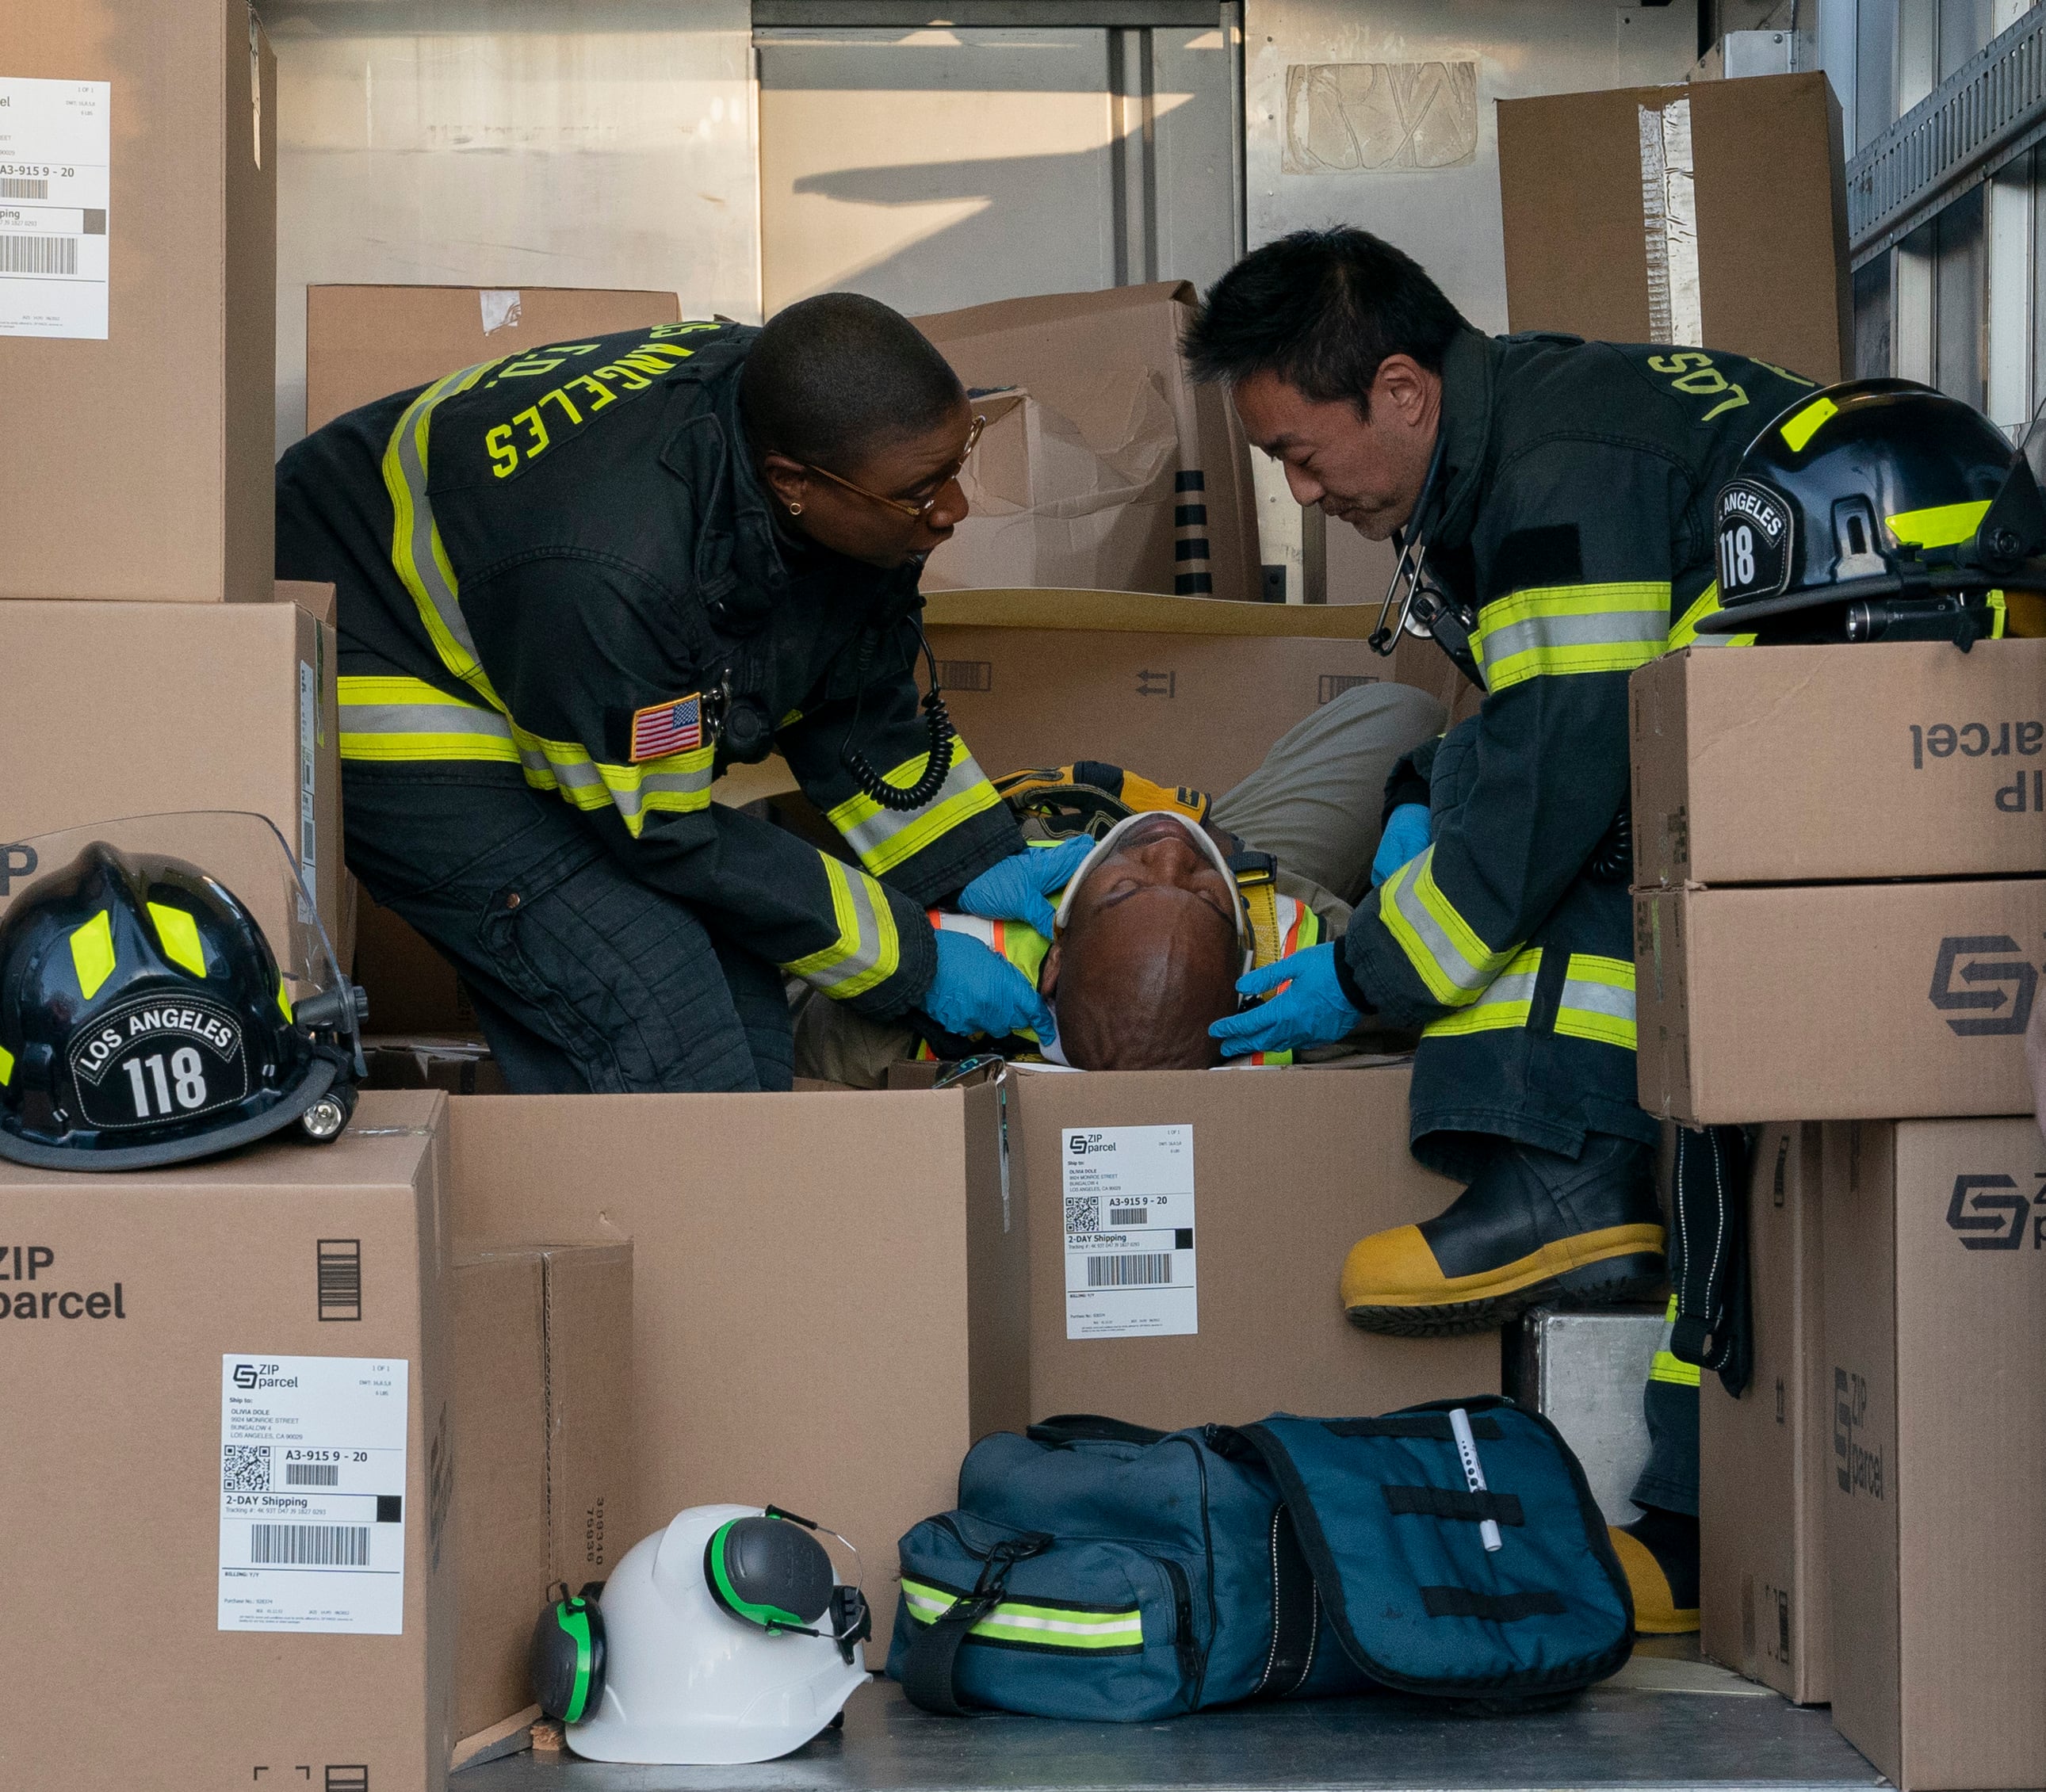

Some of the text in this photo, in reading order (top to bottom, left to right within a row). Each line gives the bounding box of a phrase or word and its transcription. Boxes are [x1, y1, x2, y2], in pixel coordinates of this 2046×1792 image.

[0, 96, 10, 107] el
[0, 165, 40, 175] A3-915
[43, 166, 49, 176] 9
[61, 167, 75, 177] 20
[0, 209, 20, 220] ping
[1647, 353, 1750, 422] LOS
[485, 343, 695, 478] ANGELES
[1724, 492, 1782, 536] ANGELES
[1719, 525, 1754, 589] 118
[1910, 721, 2044, 770] arcel
[1995, 770, 2044, 812] IP
[80, 1008, 232, 1072] LOS ANGELES
[122, 1047, 207, 1118] 118
[1088, 1134, 1103, 1143] ZIP
[1088, 1142, 1116, 1154] parcel
[1109, 1198, 1140, 1206] A3-915
[1142, 1197, 1148, 1205] 9
[1157, 1196, 1168, 1205] 20
[1094, 1234, 1126, 1244] Shipping
[258, 1364, 279, 1375] ZIP
[258, 1377, 298, 1389] parcel
[285, 1450, 328, 1461] A3-915
[333, 1451, 341, 1461] 9
[353, 1452, 368, 1462] 20
[226, 1496, 308, 1508] 2-DAY Shipping
